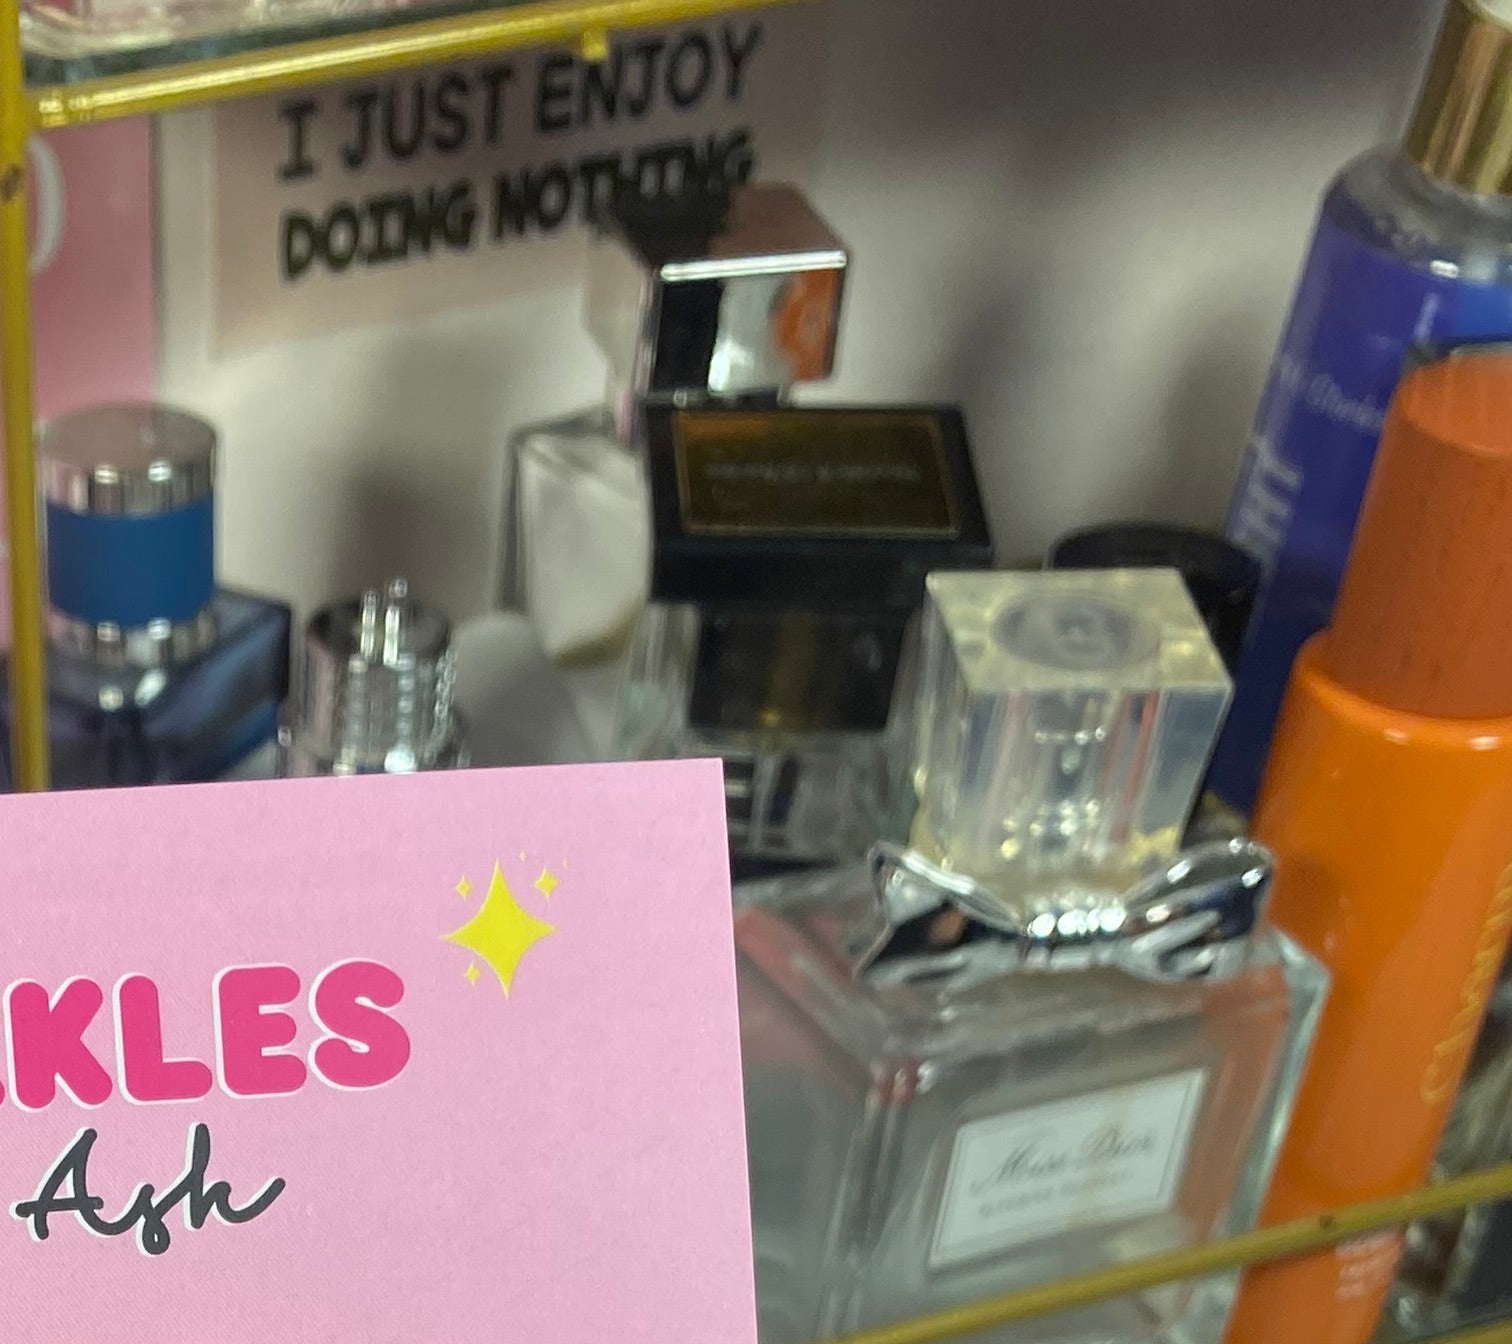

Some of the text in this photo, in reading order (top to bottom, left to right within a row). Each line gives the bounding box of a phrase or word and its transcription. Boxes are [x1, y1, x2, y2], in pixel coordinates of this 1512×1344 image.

[277, 21, 764, 183] I JUST ENJOY
[278, 180, 477, 282] DOING
[10, 1122, 287, 1257] Ash
